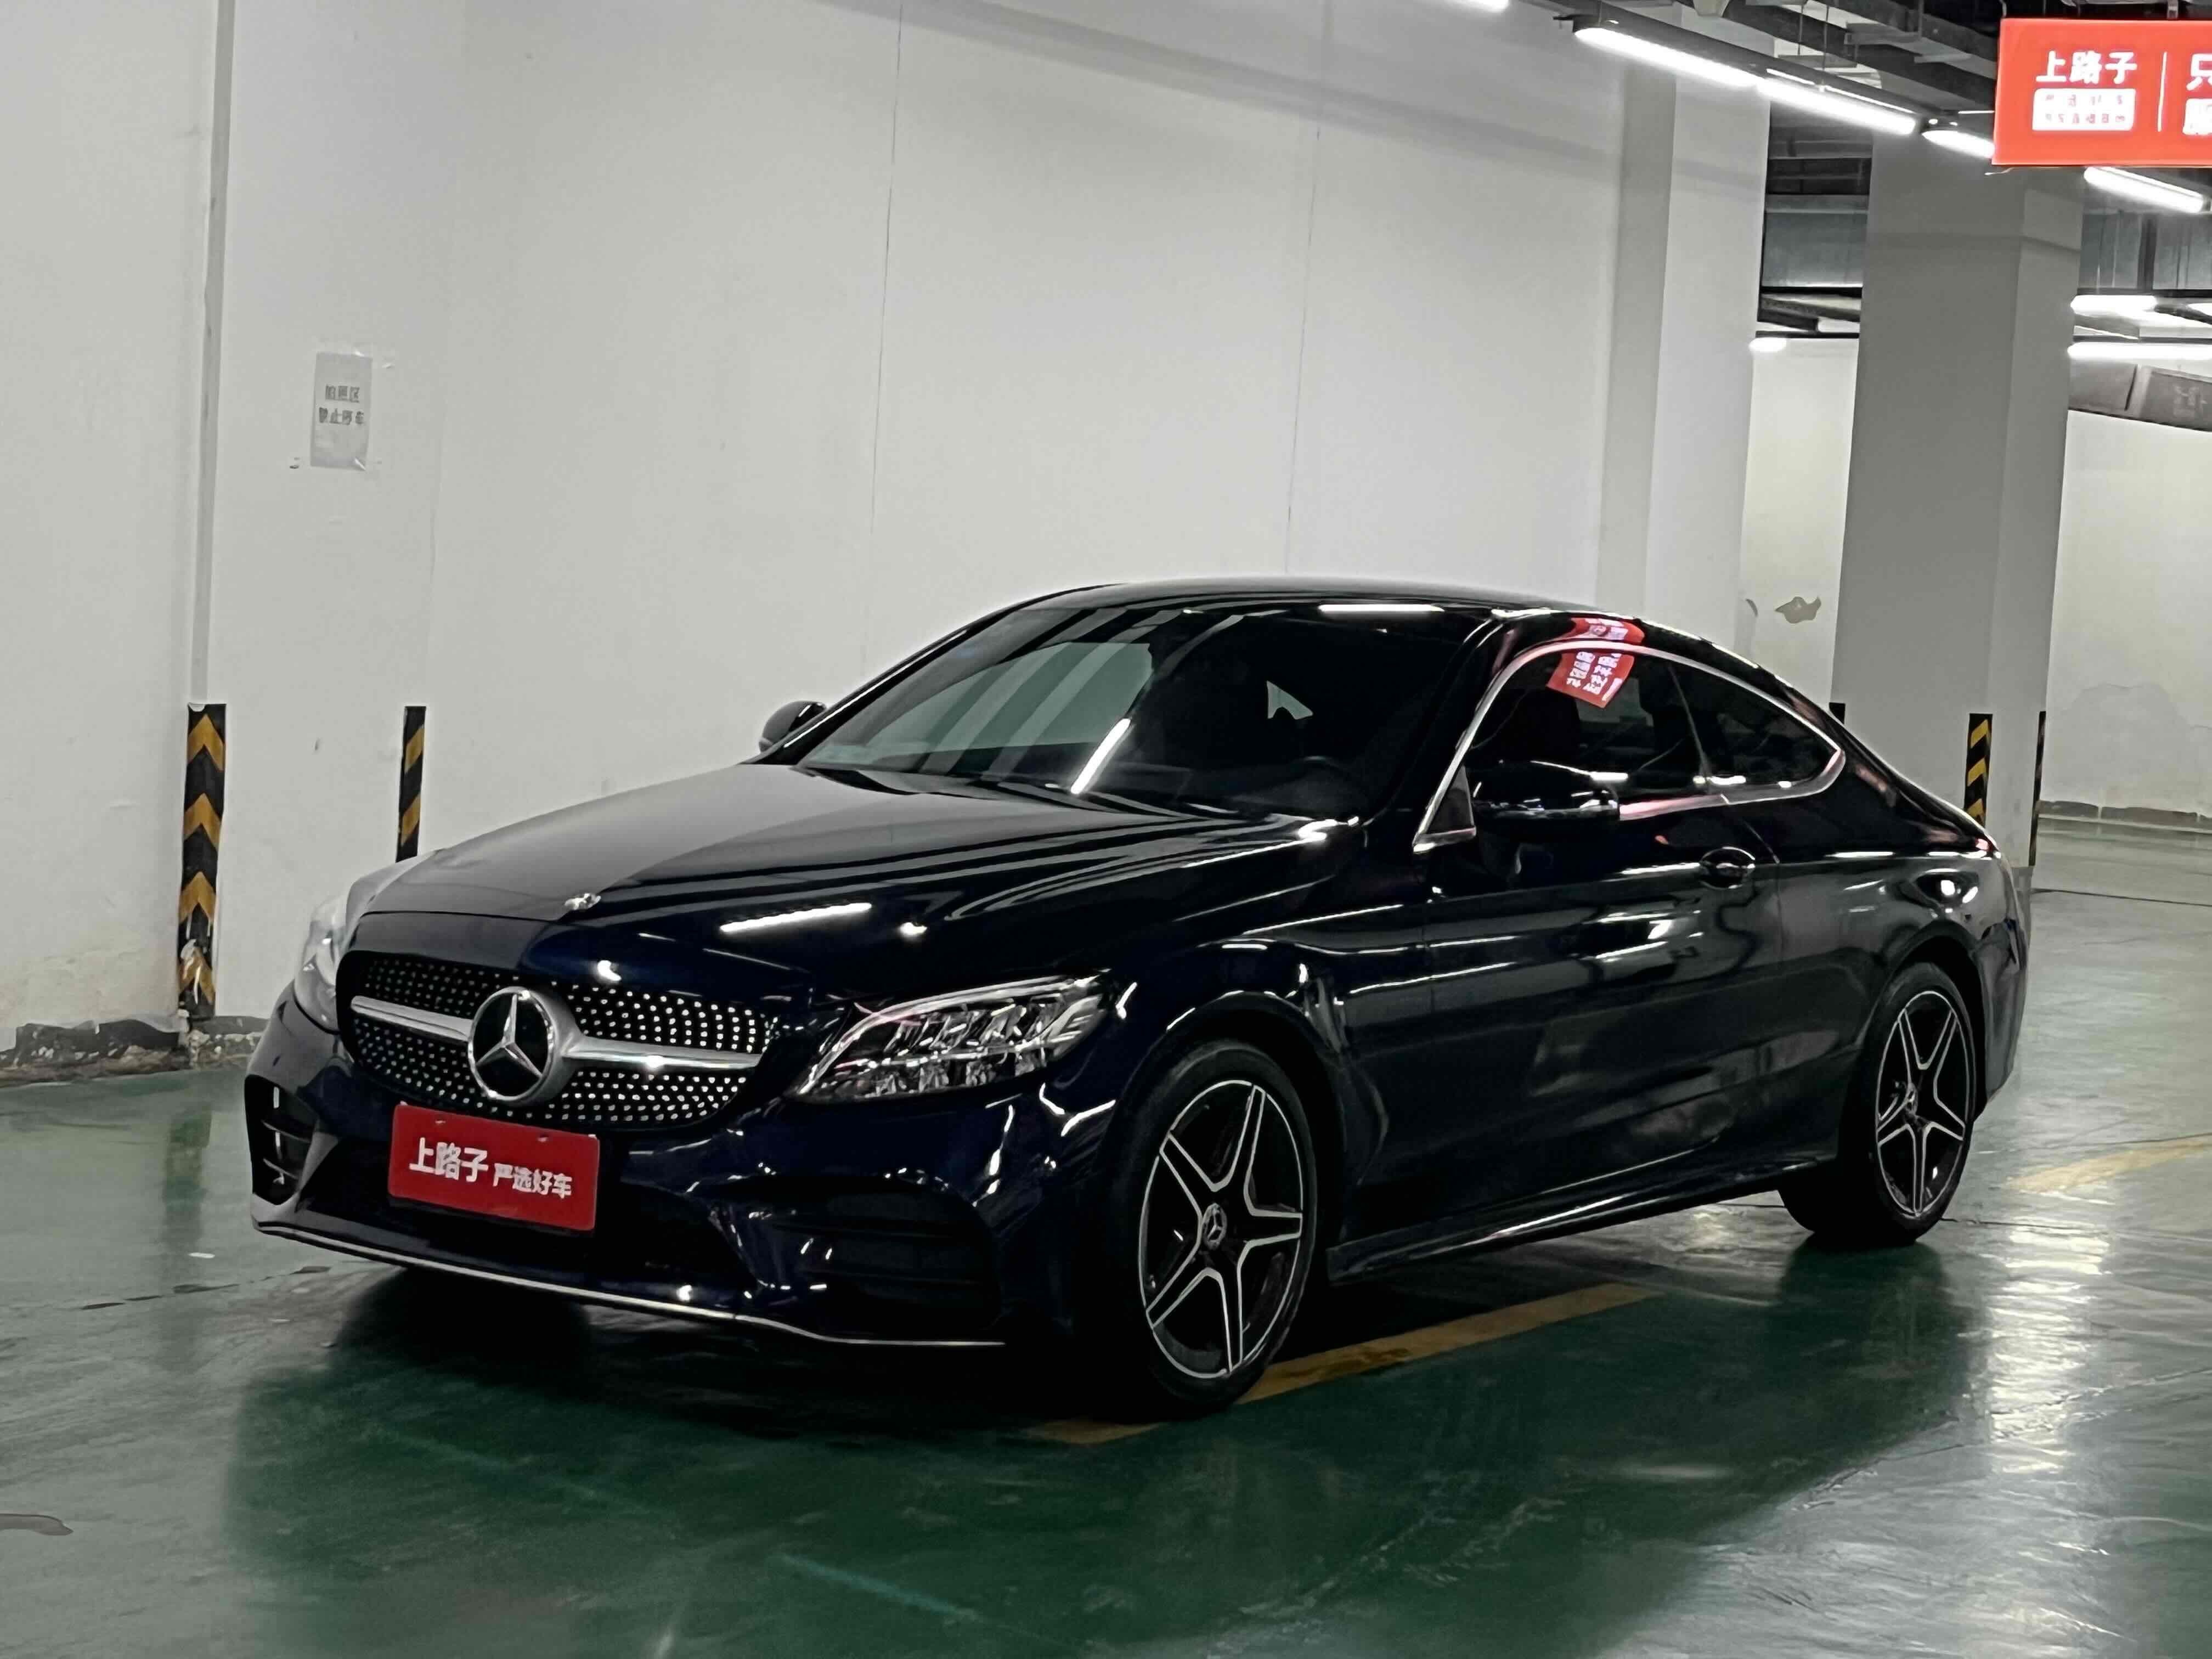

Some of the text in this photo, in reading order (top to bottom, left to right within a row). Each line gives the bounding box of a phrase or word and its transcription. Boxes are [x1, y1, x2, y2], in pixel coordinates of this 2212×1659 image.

[2036, 50, 2137, 84] 上路子
[409, 1137, 572, 1199] 上路子 严选好车
